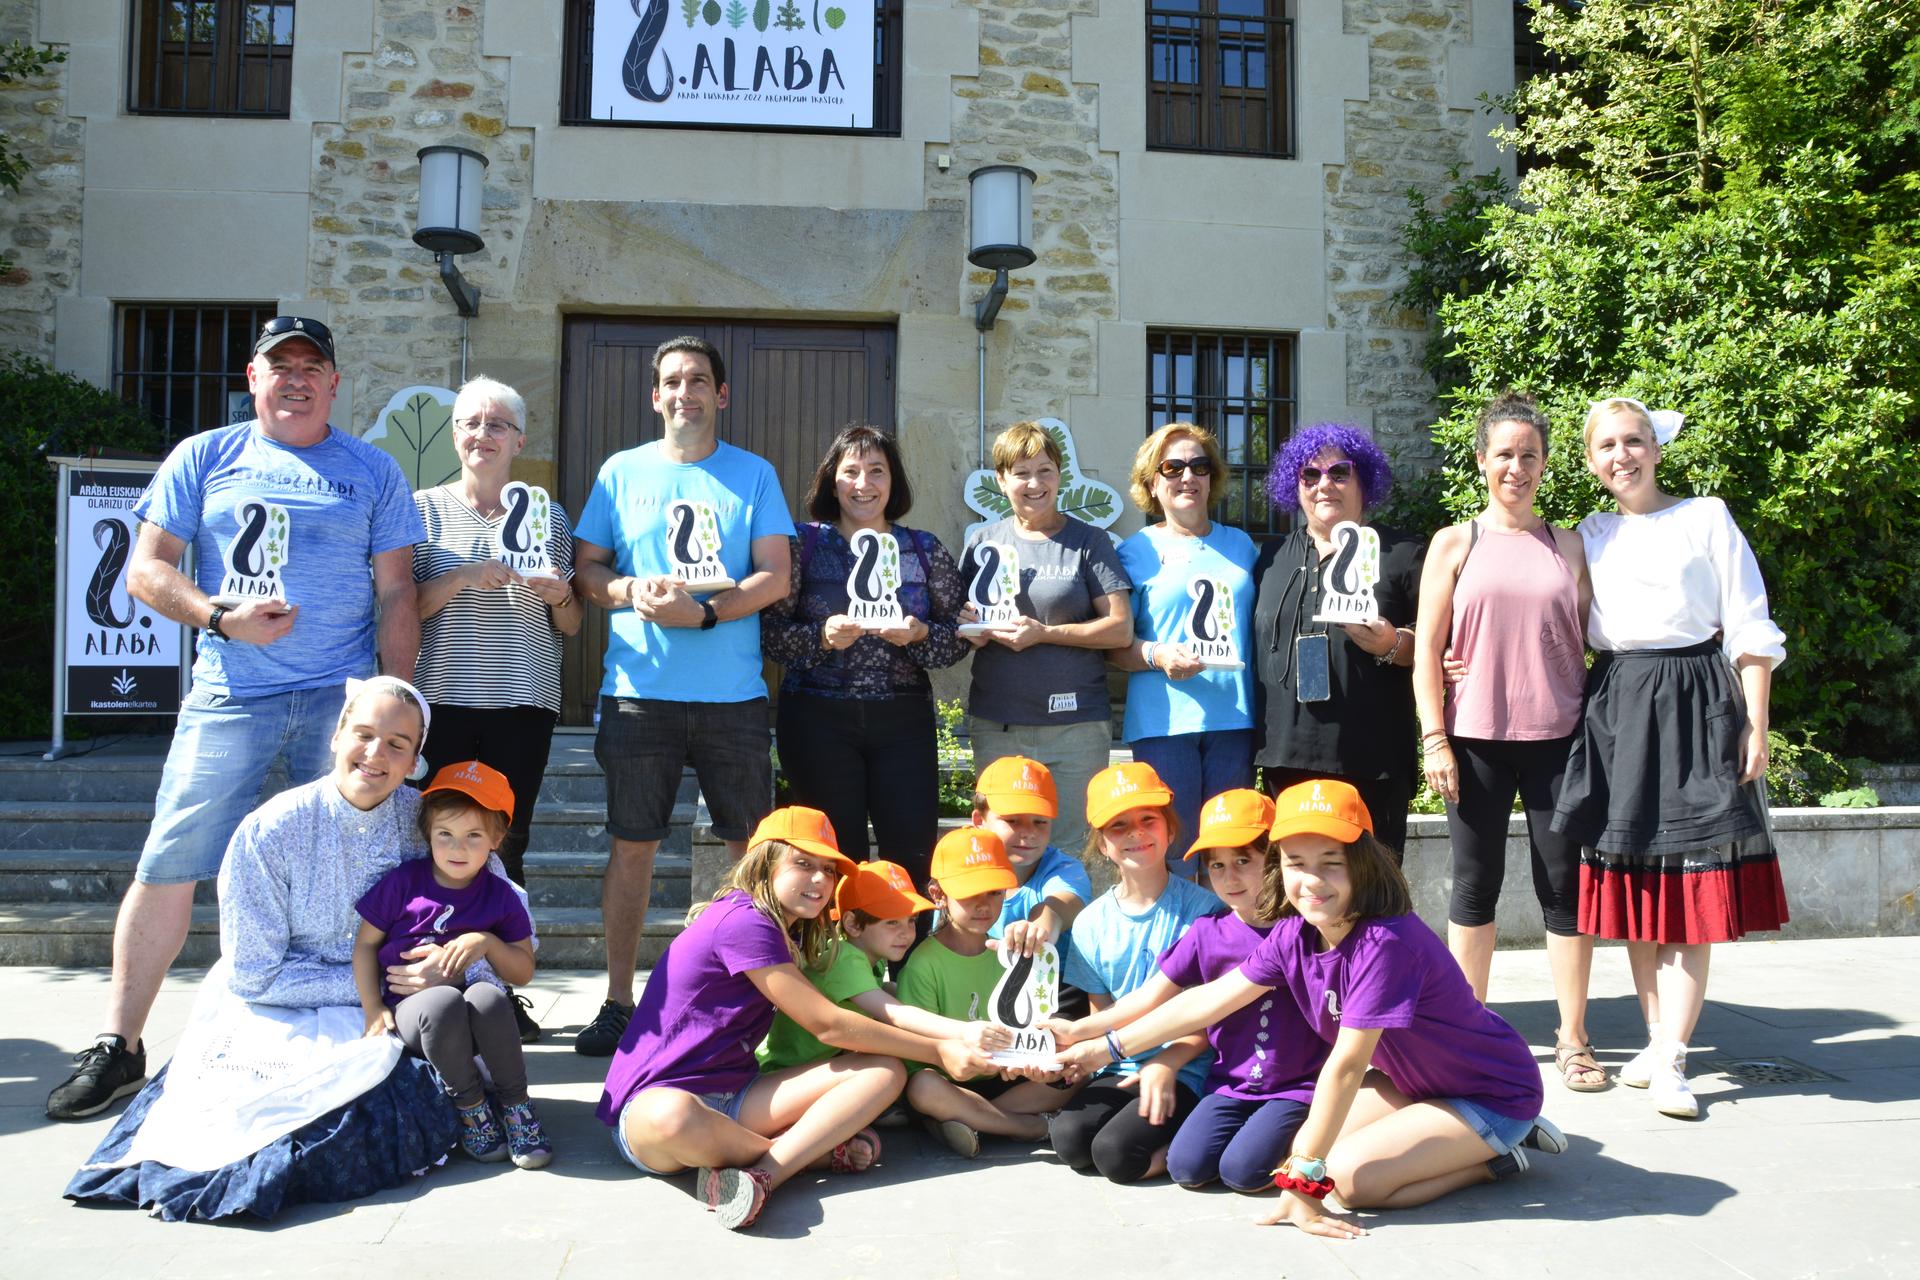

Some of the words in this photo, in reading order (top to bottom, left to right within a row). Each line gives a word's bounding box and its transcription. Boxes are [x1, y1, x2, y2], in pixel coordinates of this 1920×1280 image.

[703, 93, 741, 101] EUSKARAZ
[743, 93, 762, 102] 2022
[80, 485, 108, 497] ARABA
[88, 498, 122, 509] OLARIZU
[228, 576, 278, 597] ALABA
[854, 602, 897, 618] ALABA
[1329, 595, 1371, 613] ALABA
[85, 630, 161, 655] ALABA
[1193, 641, 1233, 657] ALABA
[1015, 1032, 1048, 1052] ABA
